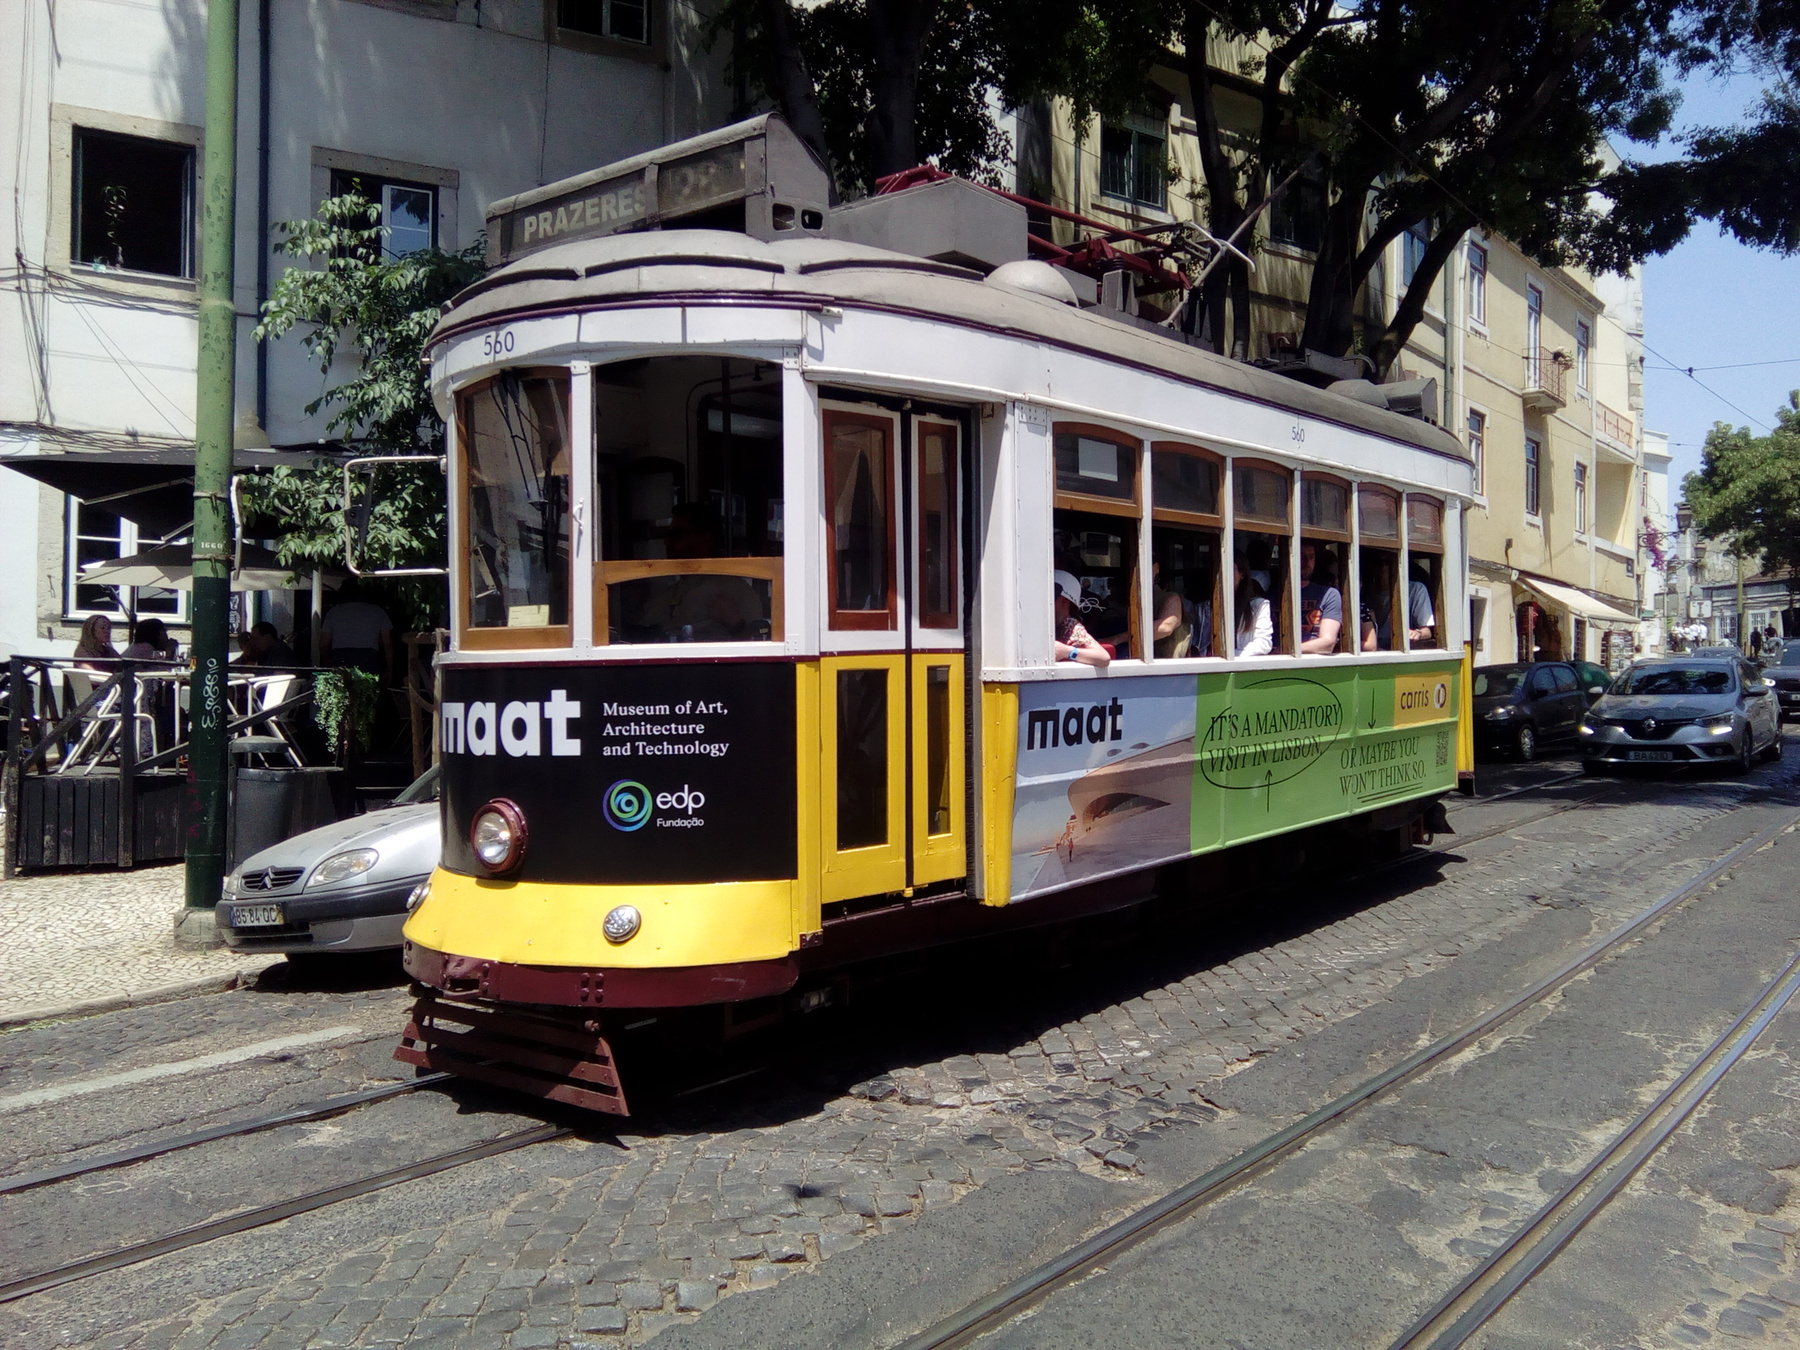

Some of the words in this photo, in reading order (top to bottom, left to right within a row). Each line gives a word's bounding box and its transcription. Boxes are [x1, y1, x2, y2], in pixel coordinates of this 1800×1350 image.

[523, 189, 647, 243] PRAZERES
[484, 331, 515, 356] 560
[1291, 426, 1305, 443] 560
[200, 541, 223, 550] 1660
[602, 702, 671, 716] Museum
[674, 700, 693, 715] of
[695, 700, 728, 715] Art,
[1400, 683, 1429, 710] carris
[442, 689, 581, 757] maat
[602, 721, 705, 736] Architecture
[1027, 696, 1123, 750] maat
[1210, 713, 1239, 741] IT'S
[1241, 713, 1252, 738] A
[1255, 703, 1342, 736] MANDATORY
[602, 742, 632, 756] and
[635, 740, 730, 757] Technology
[1208, 744, 1250, 773] VISIT
[1252, 741, 1270, 767] IN
[1340, 747, 1357, 770] OR
[1359, 740, 1398, 767] MAYBE
[1400, 736, 1420, 758] YOU
[1340, 769, 1378, 796] WON'T
[1379, 762, 1411, 788] THINK
[1412, 760, 1427, 781] SO.
[655, 784, 705, 815] edp
[656, 817, 705, 829] Fundação
